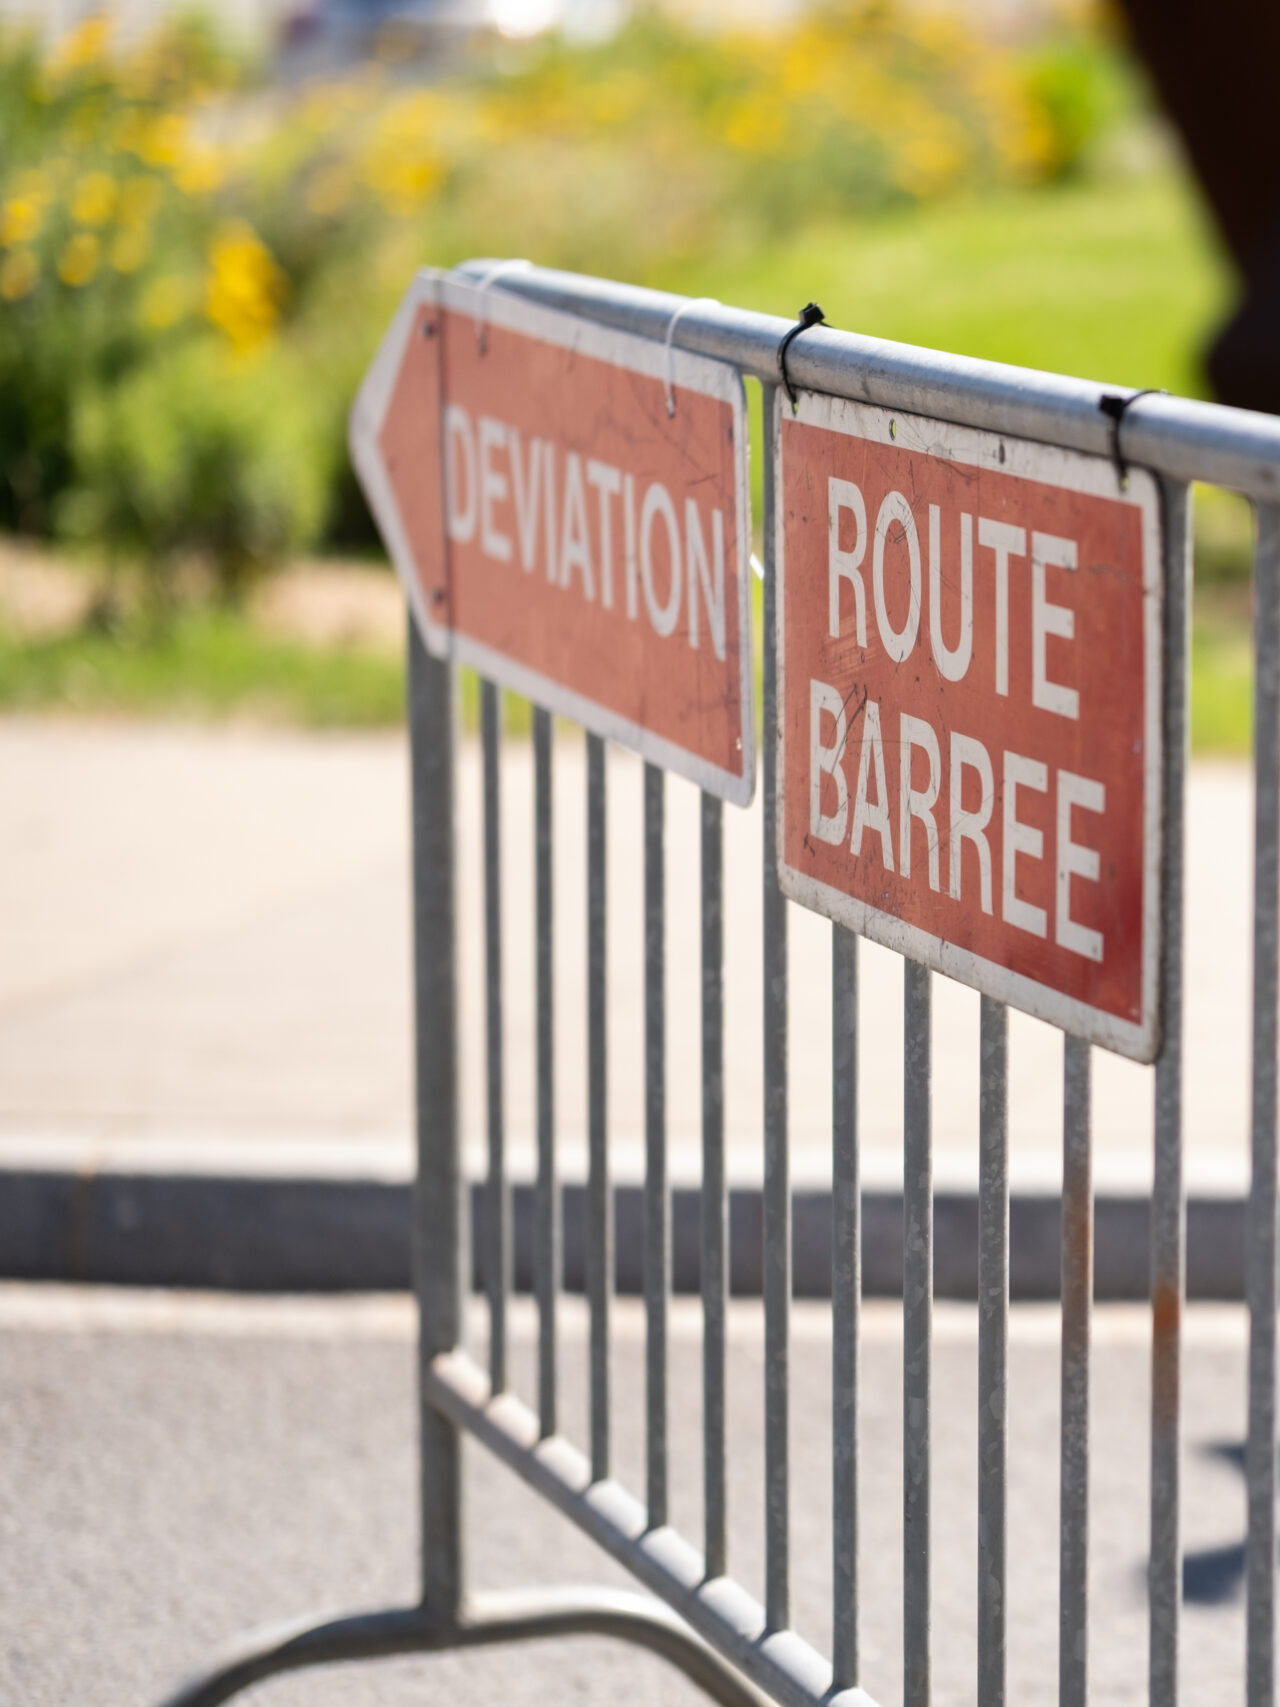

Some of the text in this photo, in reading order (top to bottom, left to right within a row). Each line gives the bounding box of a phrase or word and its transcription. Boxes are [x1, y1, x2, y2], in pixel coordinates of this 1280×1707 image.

[444, 404, 727, 662] DEVIATION
[827, 476, 1081, 720] ROUTE
[808, 680, 1107, 960] BARREE
